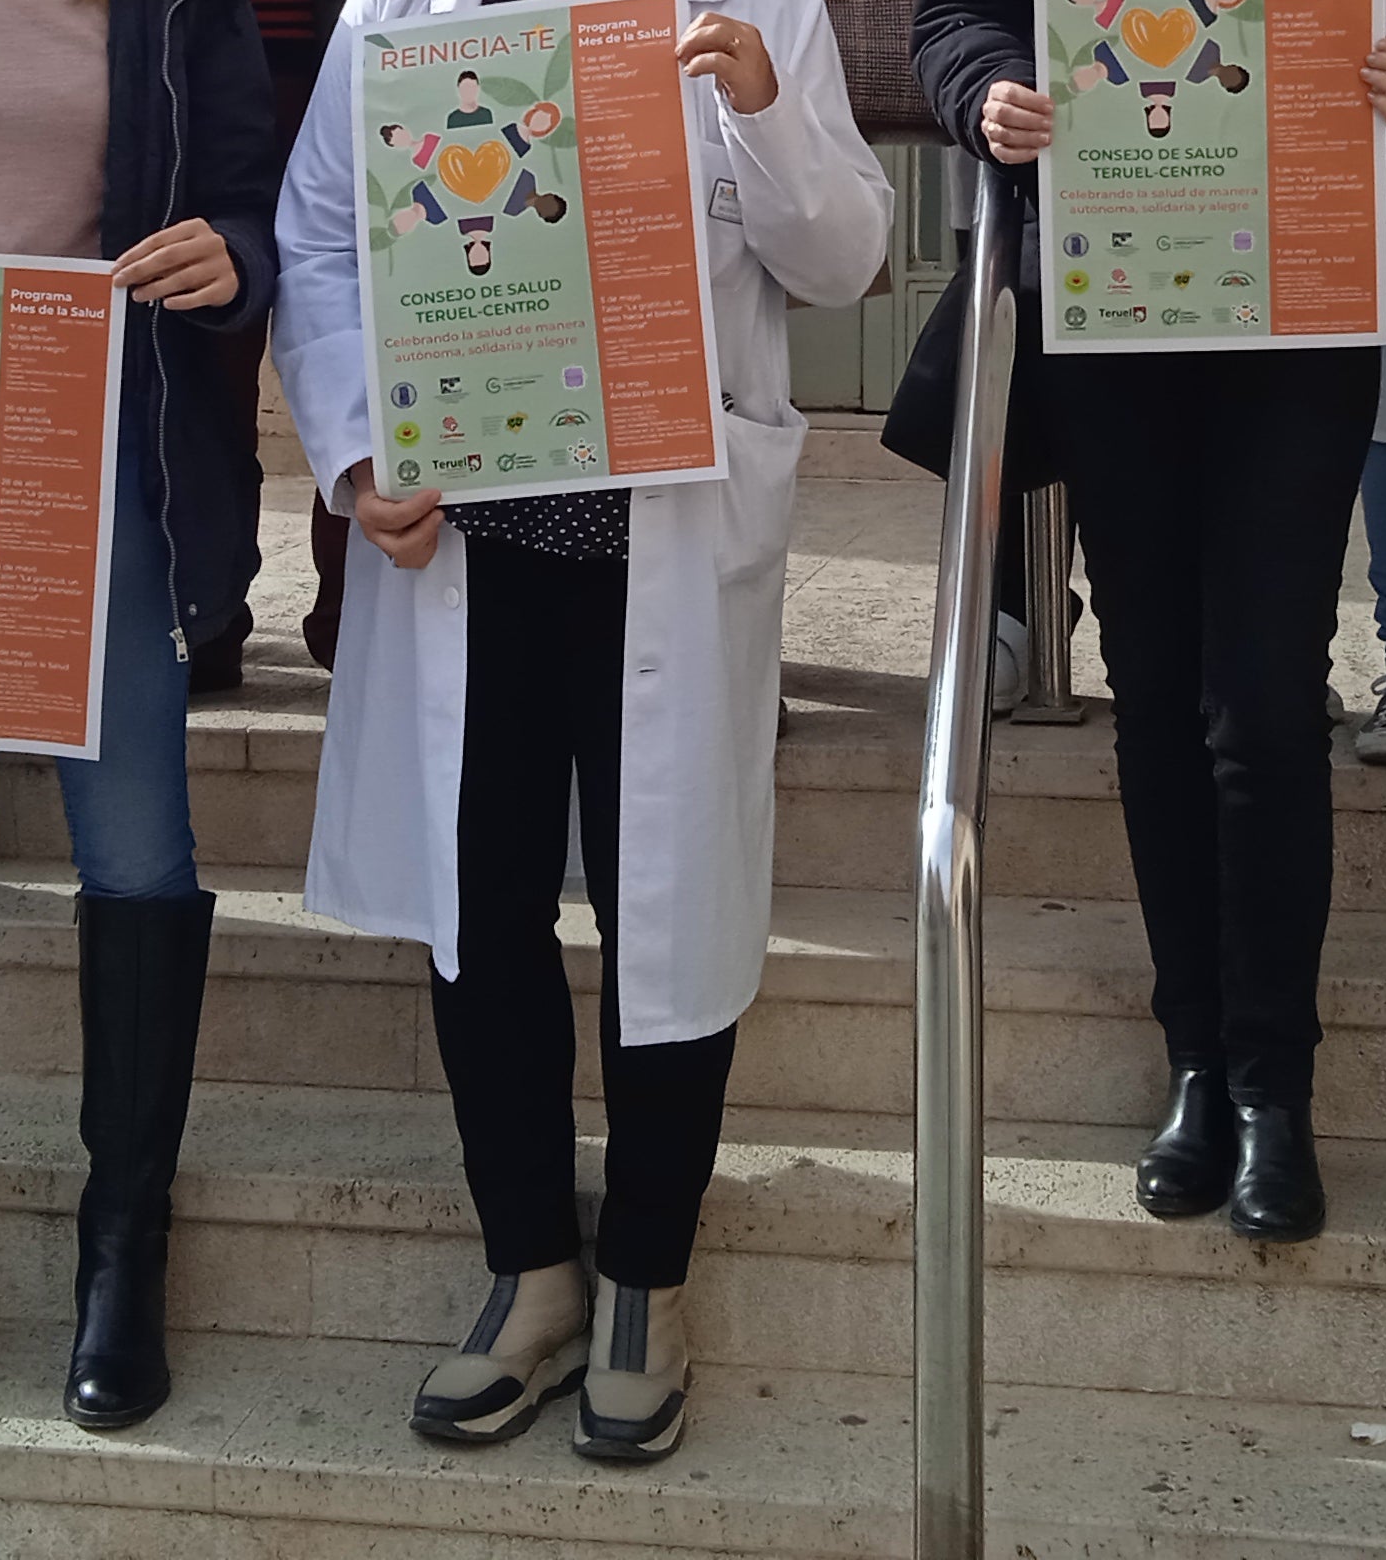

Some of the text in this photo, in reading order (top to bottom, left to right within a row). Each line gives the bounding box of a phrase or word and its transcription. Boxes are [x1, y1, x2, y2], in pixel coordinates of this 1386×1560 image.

[577, 17, 637, 35] Programa
[578, 26, 670, 47] Mes de la Salud
[380, 27, 555, 71] REINICIA-TE
[1077, 146, 1238, 161] CONSEJO DE SALUD
[1091, 164, 1225, 179] TERUEL-CENTRO
[1059, 186, 1258, 200] Celebrando la salud de manera
[10, 288, 72, 304] Programa
[400, 278, 561, 307] CONSEJO DE SALUD
[10, 302, 105, 318] Mes de la Salud
[415, 297, 550, 324] TERUEL-CENTRO
[1098, 307, 1132, 318] Teruel
[384, 318, 585, 349] Celebrando la salud de manera
[468, 339, 522, 355] solidaria
[526, 340, 532, 352] y
[536, 333, 577, 350] alegre
[432, 456, 467, 470] Teruel
